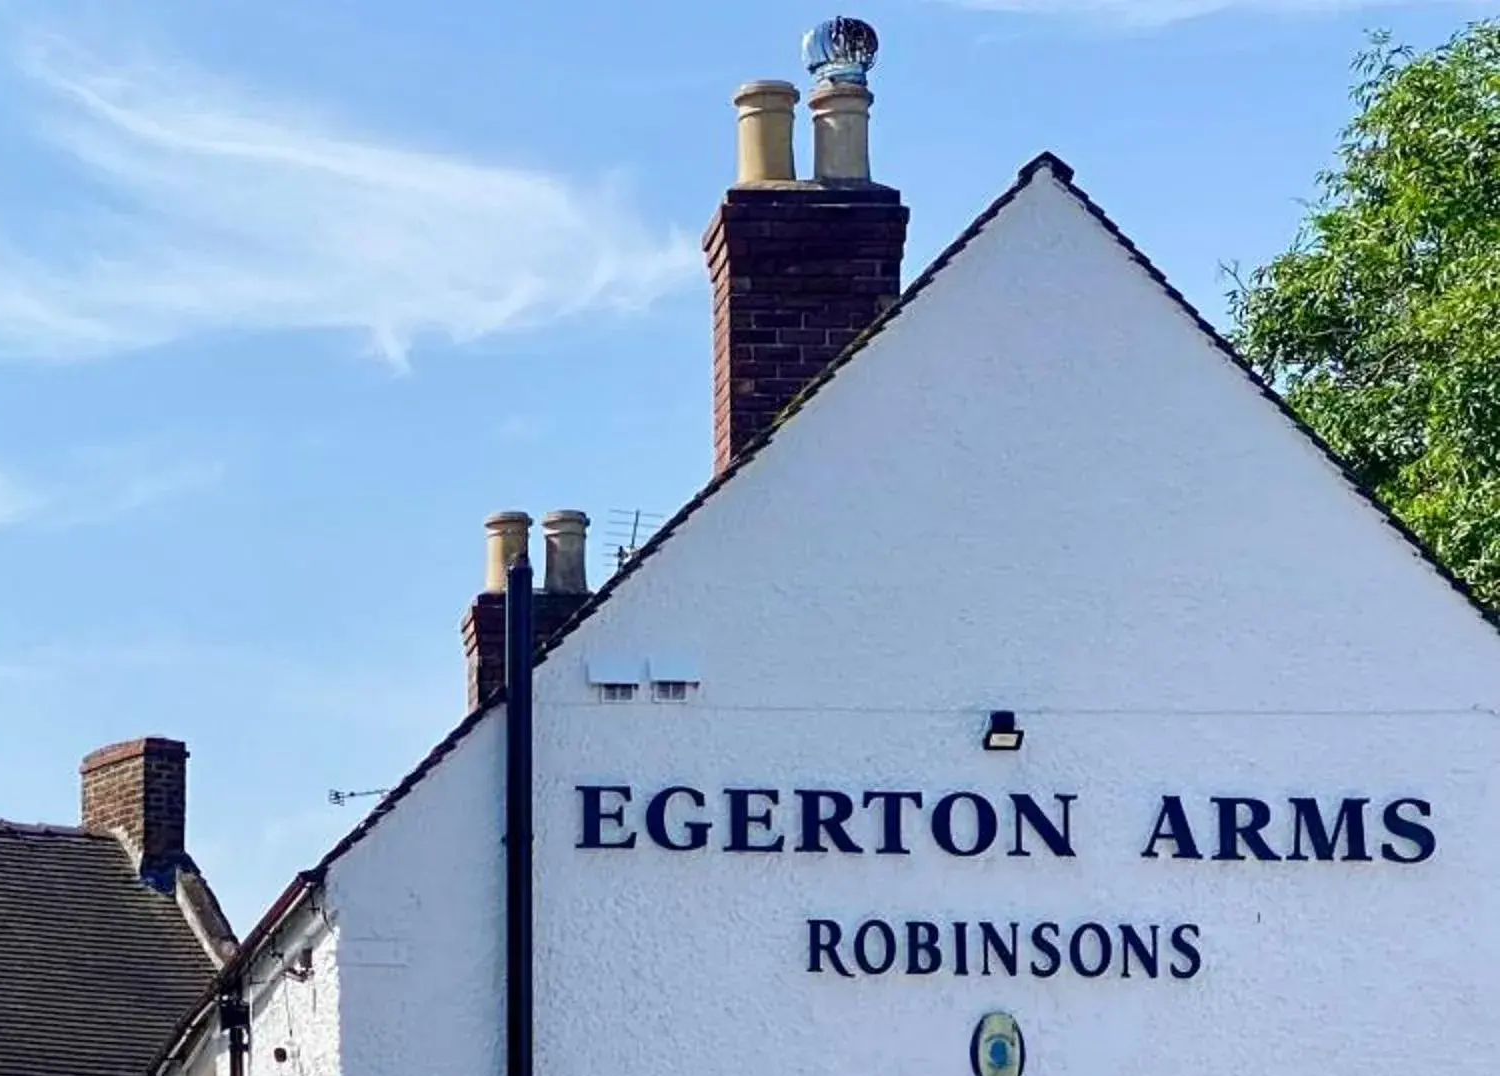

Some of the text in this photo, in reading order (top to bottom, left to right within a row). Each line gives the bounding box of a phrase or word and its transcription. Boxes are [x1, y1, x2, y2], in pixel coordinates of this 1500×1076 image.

[574, 785, 1436, 865] EGERTON ARMS
[806, 918, 1201, 980] ROBINSONS
